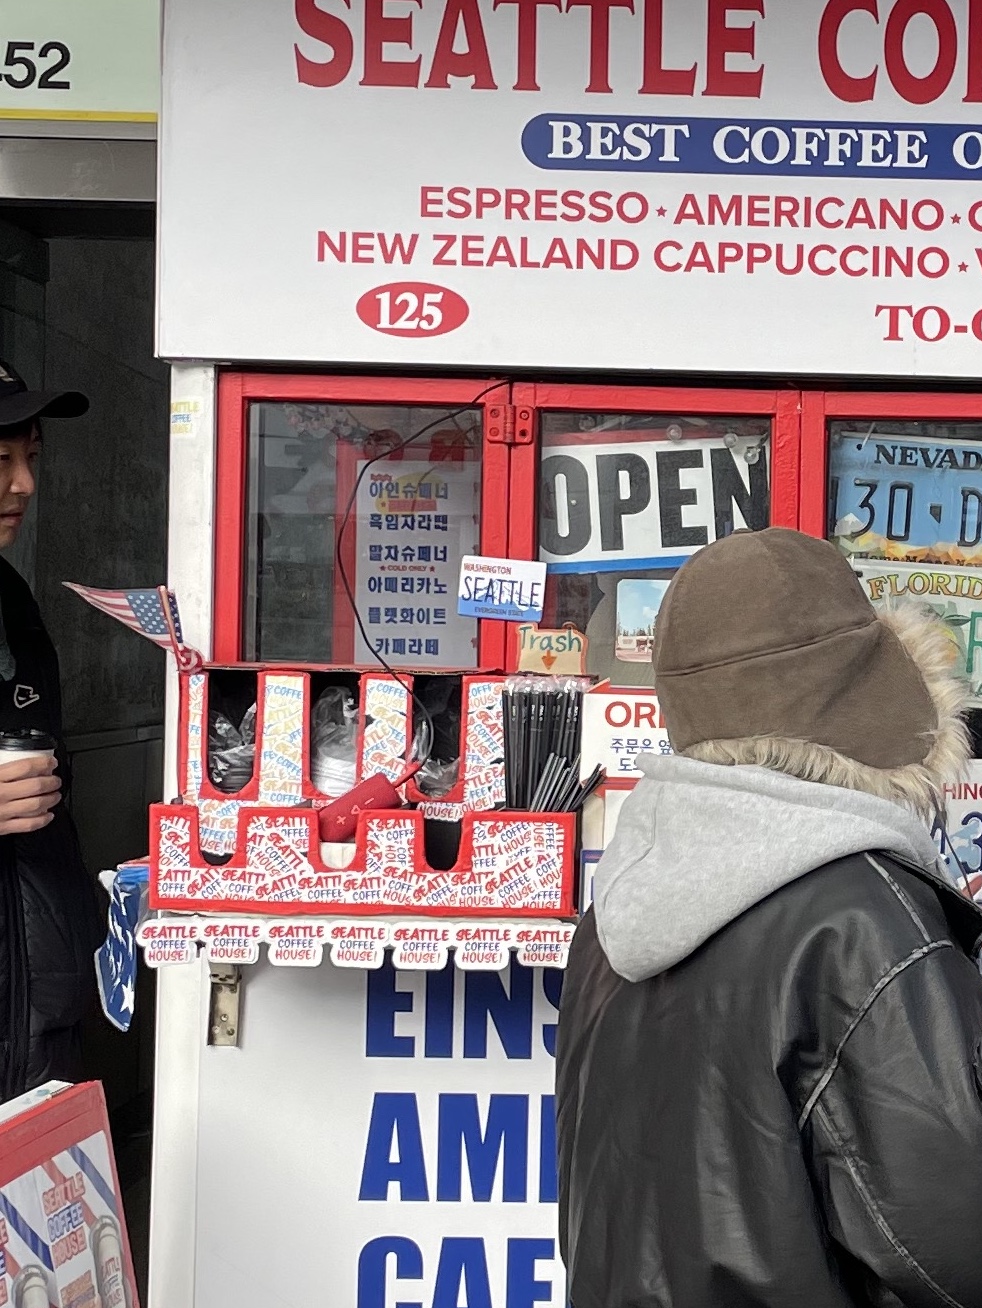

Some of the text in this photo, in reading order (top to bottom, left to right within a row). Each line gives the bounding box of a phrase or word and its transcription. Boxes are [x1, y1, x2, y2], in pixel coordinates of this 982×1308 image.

[295, 0, 764, 98] SEATTLE
[0, 41, 71, 89] 52
[547, 120, 690, 162] BEST
[712, 126, 929, 168] COFFEE
[421, 186, 648, 223] ESPRESSO
[674, 194, 944, 231] AMERICANO
[318, 231, 418, 264] NEW
[431, 235, 639, 271] ZEALAND
[654, 240, 949, 278] CAPPUCCINO
[375, 291, 444, 331] 125
[540, 446, 769, 555] OPEN
[461, 576, 542, 607] SEATTLE
[519, 625, 582, 652] Trash
[142, 926, 197, 939] SEATTLE
[204, 925, 260, 937] SEATTLE
[269, 926, 324, 938] SEATTLE
[331, 927, 385, 940] SEATTLE
[394, 928, 449, 941] SEATTLE
[456, 928, 511, 941] SEATTLE
[517, 930, 571, 942] SEATTLE
[151, 940, 186, 949] COFFEE
[213, 938, 249, 947] COFFEE
[278, 939, 313, 948] COFFEE
[340, 940, 375, 950] COFFEE
[403, 942, 438, 951] COFFEE
[465, 942, 500, 951] COFFEE
[525, 943, 561, 952] COFFEE
[148, 950, 188, 961] HOUSE!
[210, 948, 252, 958] HOUSE!
[275, 949, 315, 960] HOUSE!
[337, 951, 377, 962] HOUSE!
[400, 952, 440, 963] HOUSE!
[462, 952, 502, 963] HOUSE!
[523, 953, 563, 963] HOUSE!
[47, 1201, 84, 1243] COFFEE
